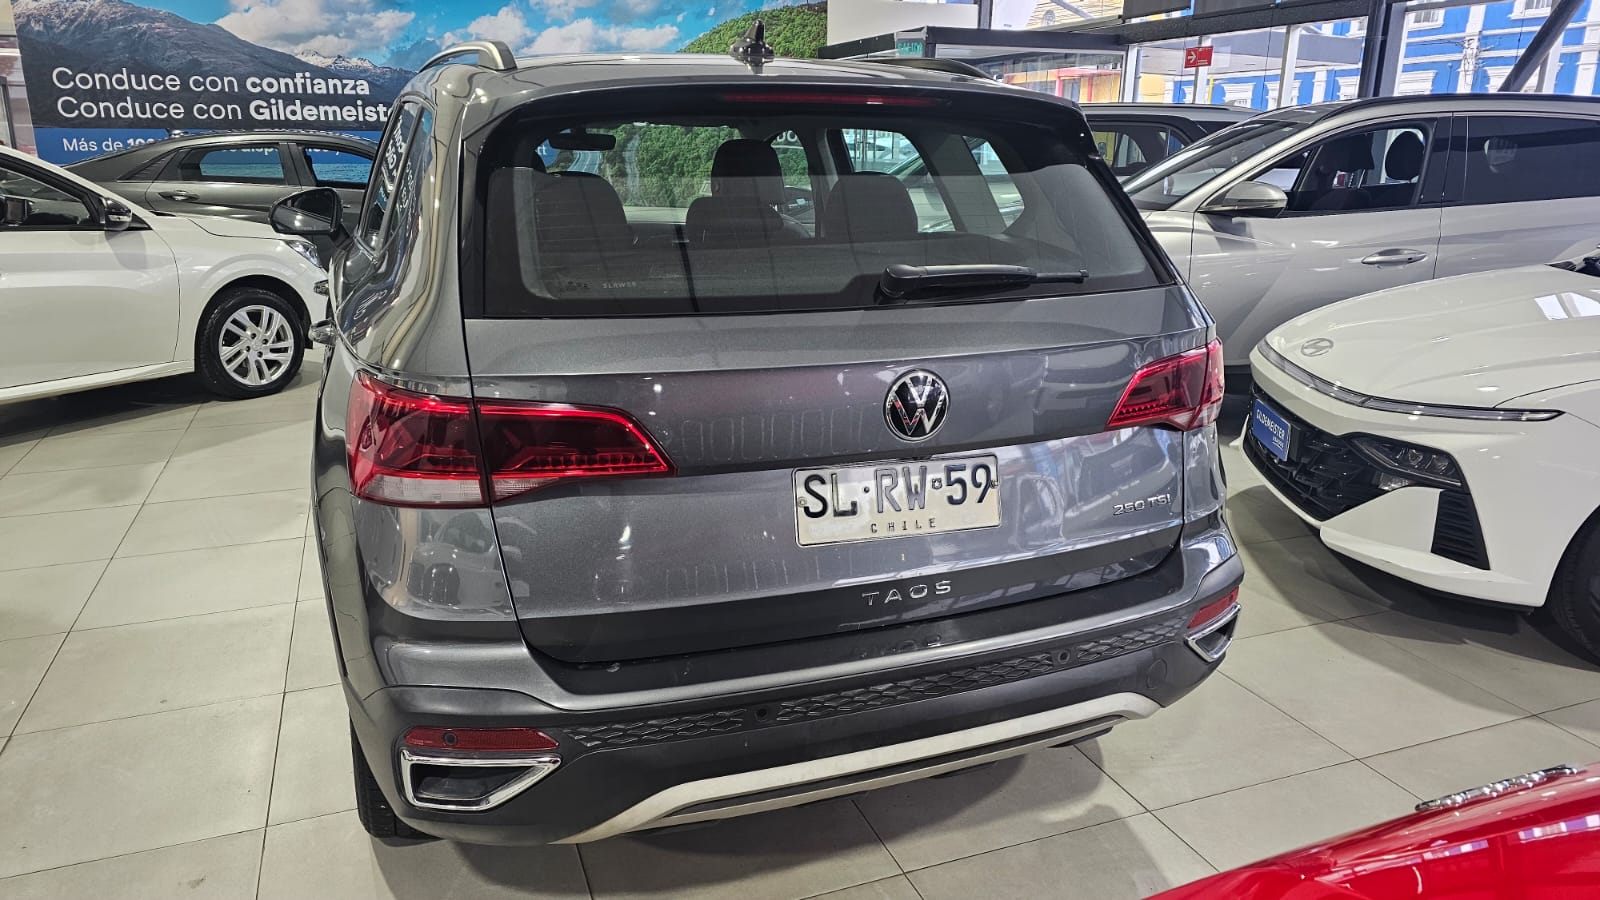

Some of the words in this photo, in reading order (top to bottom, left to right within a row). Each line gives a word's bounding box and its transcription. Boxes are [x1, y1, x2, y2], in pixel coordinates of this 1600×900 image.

[52, 66, 181, 91] Conduce
[189, 75, 239, 92] con
[246, 72, 370, 95] confianza
[57, 96, 185, 118] Conduce
[193, 102, 242, 120] con
[62, 138, 98, 151] Más
[102, 138, 123, 151] de
[1113, 500, 1145, 516] 250
[1147, 493, 1171, 508] TSI
[870, 517, 936, 534] CHILE
[861, 580, 952, 606] TAOS
